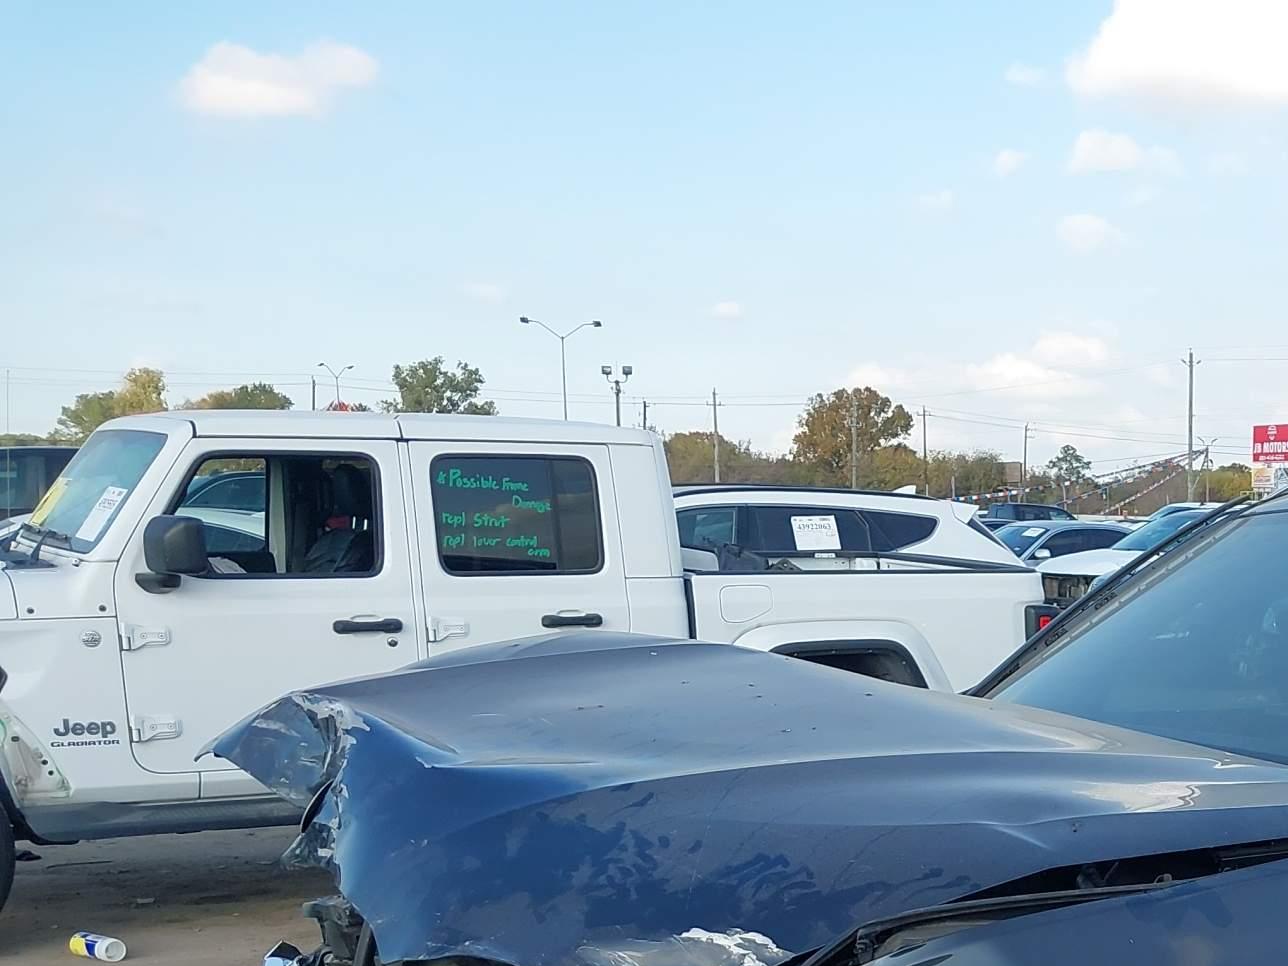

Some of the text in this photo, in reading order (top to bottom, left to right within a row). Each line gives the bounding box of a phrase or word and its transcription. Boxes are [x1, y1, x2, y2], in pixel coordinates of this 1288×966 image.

[449, 469, 500, 490] Possible
[441, 512, 466, 528] repl
[53, 718, 116, 738] Jeep
[50, 739, 120, 748] GLADIATOR
